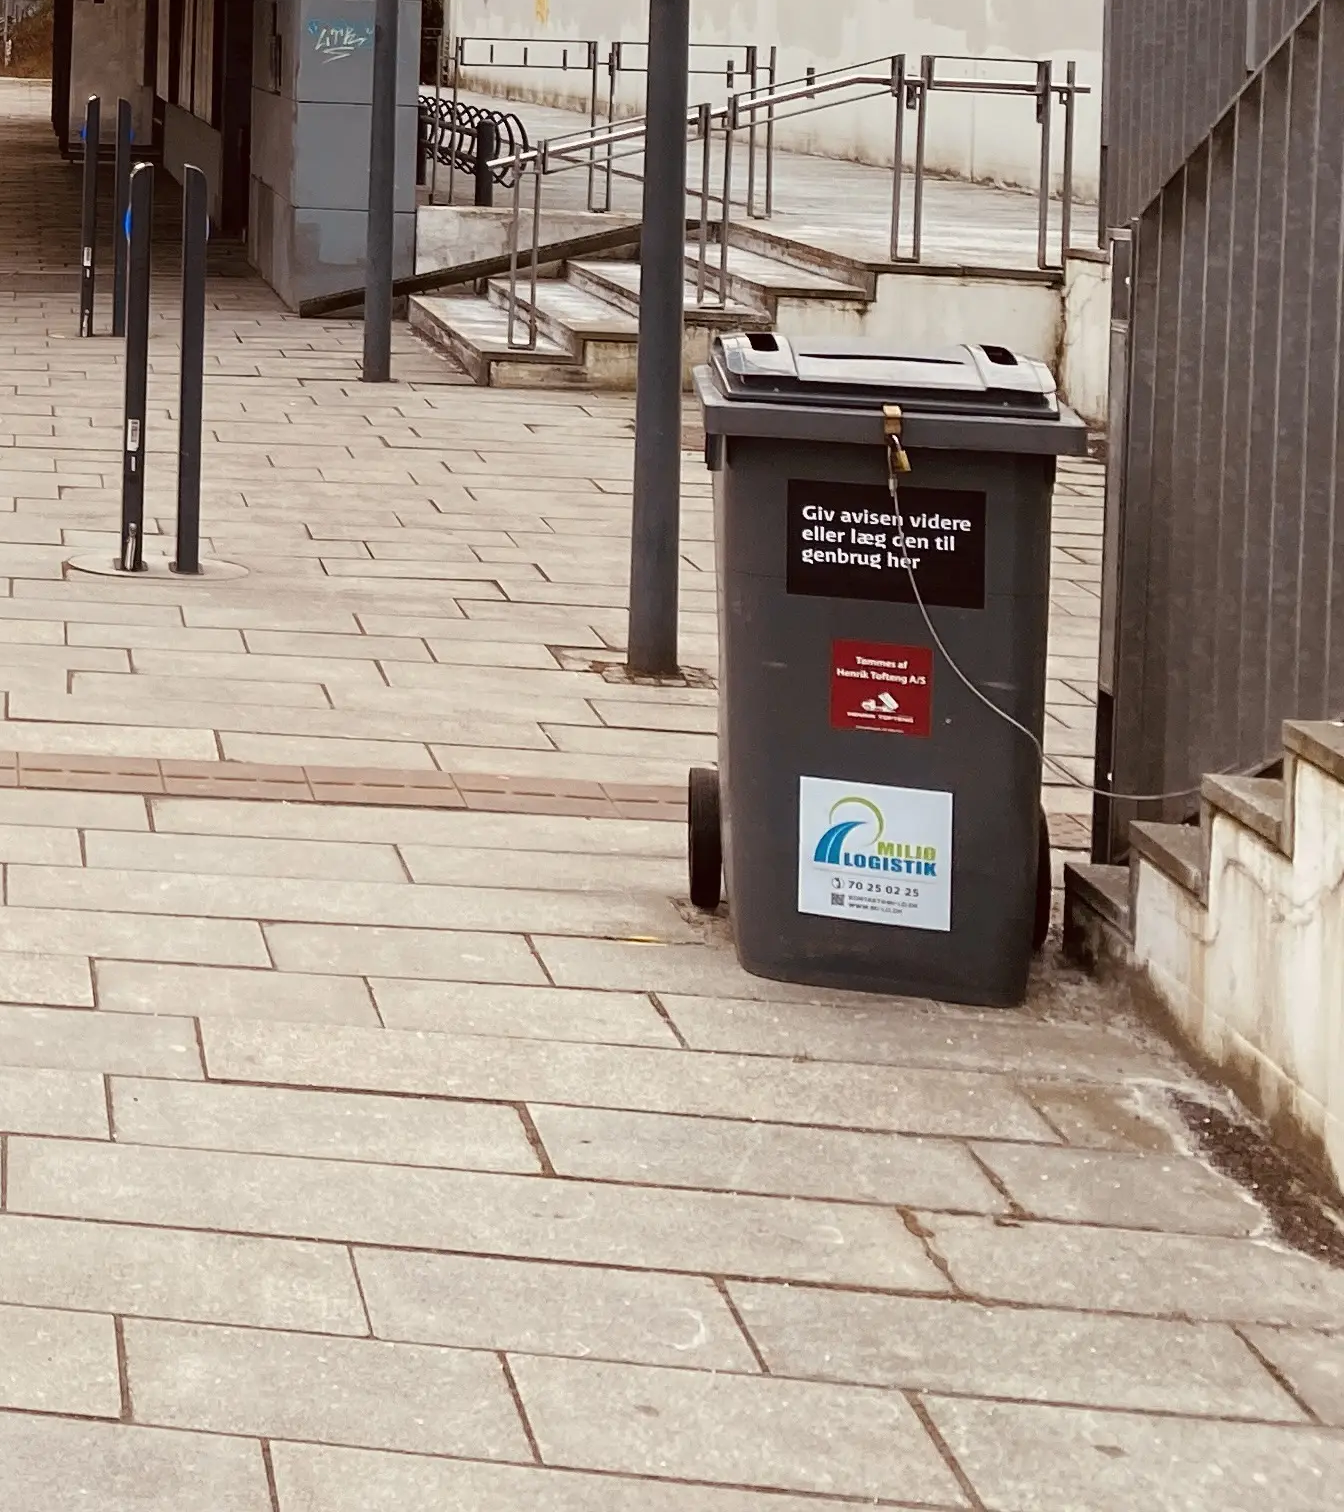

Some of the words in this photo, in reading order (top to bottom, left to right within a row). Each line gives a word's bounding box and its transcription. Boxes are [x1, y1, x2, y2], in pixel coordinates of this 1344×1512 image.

[801, 504, 836, 522] Giv
[839, 508, 904, 527] avisen
[909, 513, 972, 532] videre
[801, 525, 846, 543] eller
[850, 528, 887, 549] læg
[891, 532, 929, 550] den
[934, 535, 956, 552] til
[801, 548, 882, 570] genbrug
[886, 551, 921, 570] her
[836, 667, 869, 679] Henrik
[909, 674, 927, 685] A/S
[897, 660, 908, 670] af
[844, 852, 937, 877] LOGISTIK
[848, 879, 863, 890] 70
[867, 883, 882, 893] 25
[885, 885, 900, 895] 02
[904, 887, 919, 897] 25
